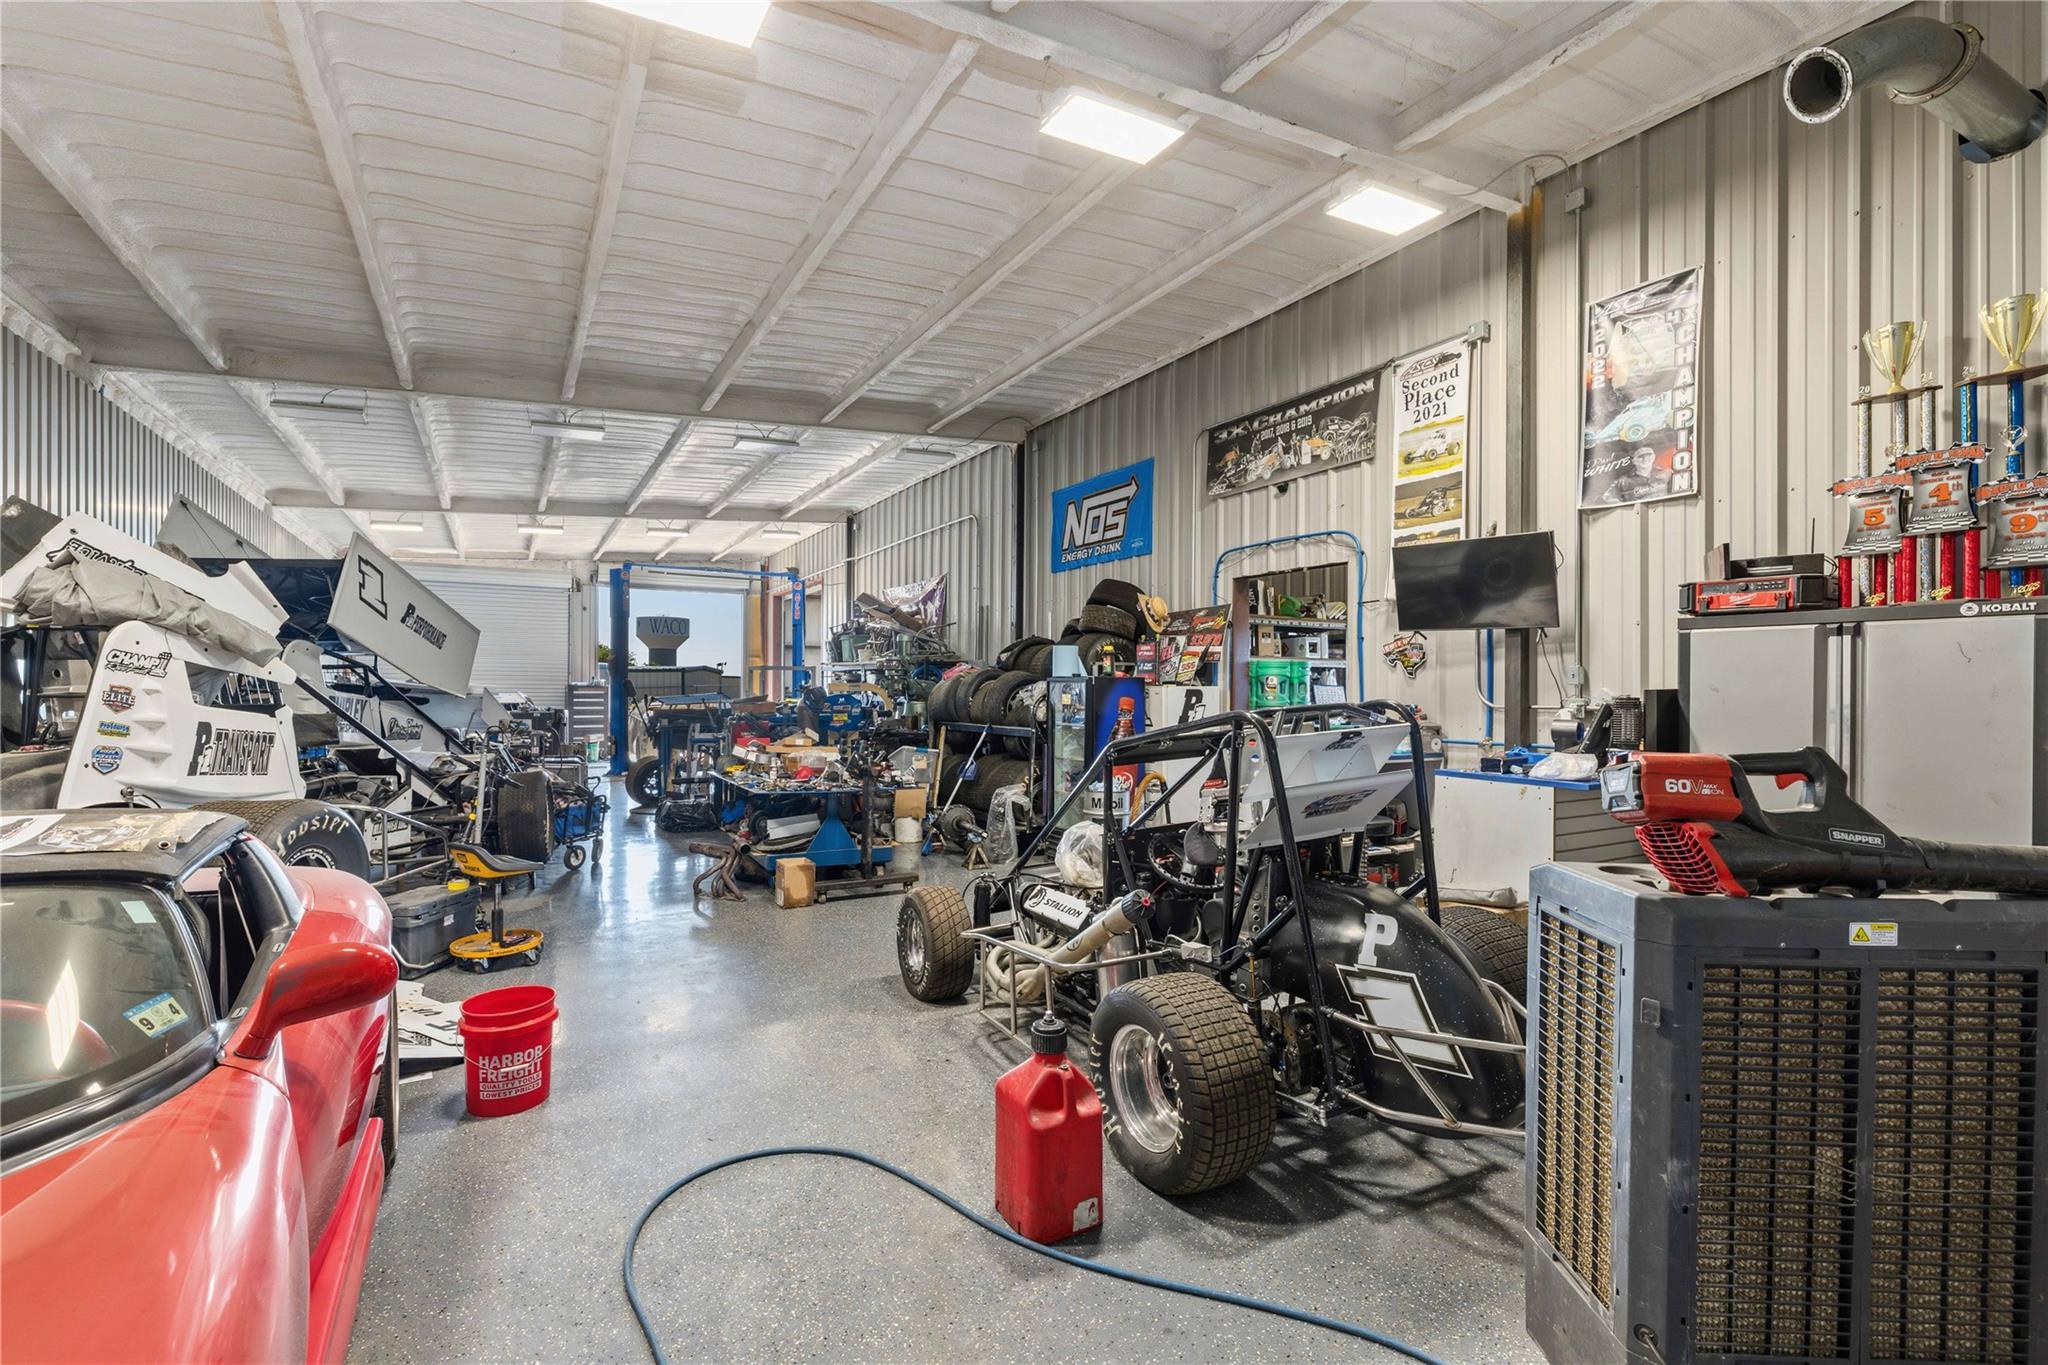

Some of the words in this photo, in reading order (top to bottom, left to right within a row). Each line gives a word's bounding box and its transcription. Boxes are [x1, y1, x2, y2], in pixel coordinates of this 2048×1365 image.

[1402, 363, 1459, 395] Second
[1252, 379, 1376, 431] CHAMPION
[1405, 384, 1457, 412] Place
[1413, 401, 1447, 424] 2021
[1276, 421, 1290, 436] 2018
[1297, 414, 1313, 429] 2019
[1063, 482, 1138, 550] NOS
[1061, 548, 1093, 563] ENERGY
[1094, 541, 1122, 556] DRINK
[1981, 602, 2038, 613] KOBALT
[648, 618, 688, 636] WACO
[209, 728, 276, 776] TRANSPORT
[1091, 797, 1124, 809] Mil
[1832, 831, 1884, 846] SNAPPER
[1043, 898, 1083, 919] STALLION
[1358, 912, 1399, 967] P
[479, 1044, 543, 1069] HARBOR
[479, 1057, 543, 1083] FREIGHT
[482, 1081, 515, 1090] QUALITY
[518, 1073, 540, 1085] TOOLS
[482, 1090, 514, 1099] LOWEST
[514, 1081, 540, 1095] PRICES
